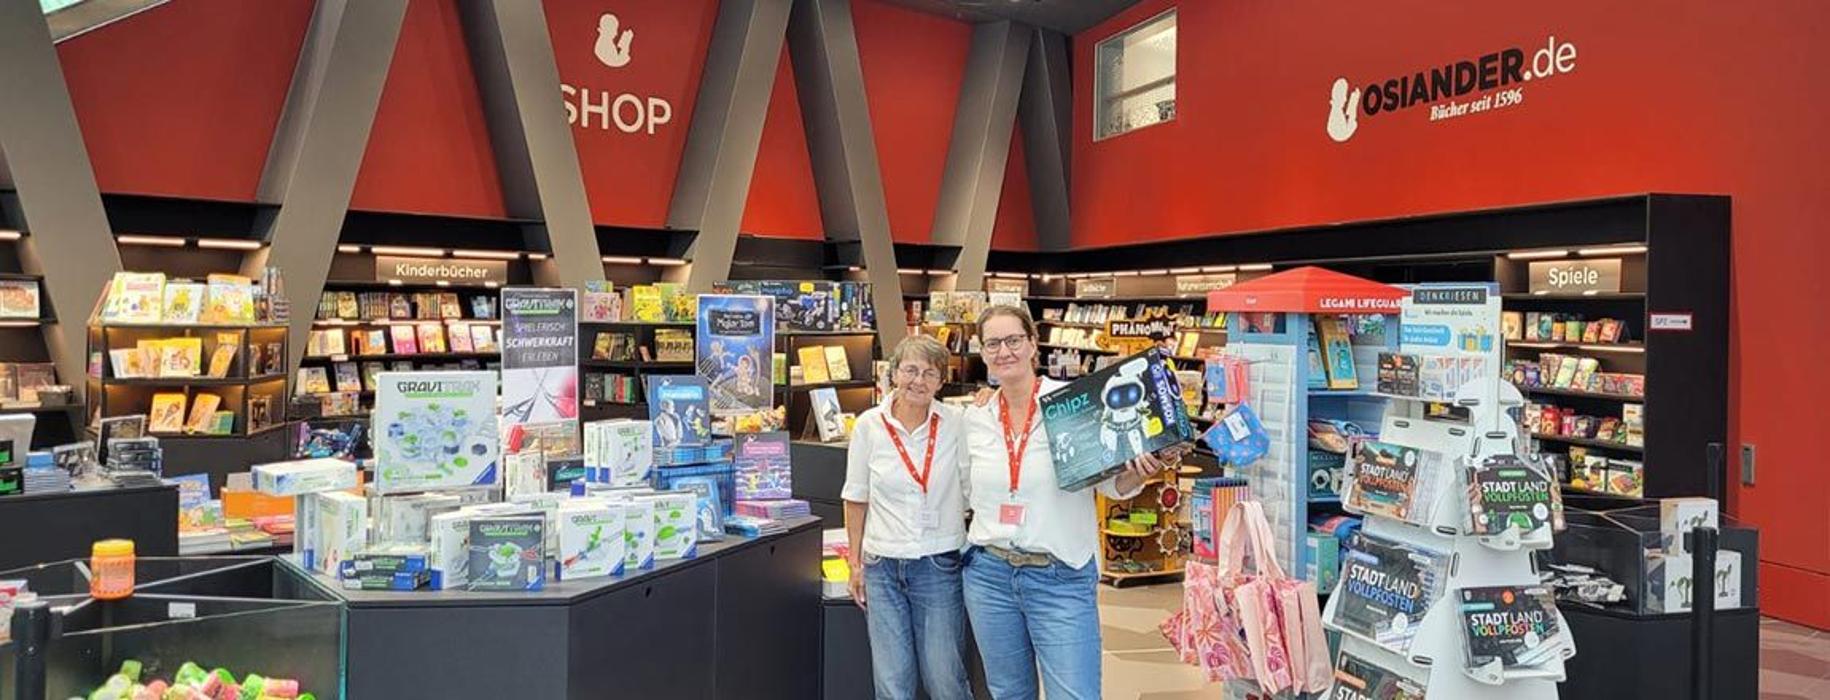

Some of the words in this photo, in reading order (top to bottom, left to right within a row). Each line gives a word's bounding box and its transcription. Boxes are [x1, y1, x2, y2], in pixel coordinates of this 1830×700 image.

[1362, 35, 1577, 116] OSIANDER.de
[560, 83, 672, 134] SHOP
[1430, 100, 1468, 121] Bücher
[1469, 95, 1491, 114] seit
[1493, 88, 1523, 109] 1596
[396, 264, 488, 279] Kinderbücher
[1549, 266, 1599, 287] Spiele
[1320, 298, 1355, 308] LEGAMI
[505, 336, 574, 349] SCHWERKRAFT
[1045, 392, 1090, 419] Chipz
[1156, 380, 1176, 425] KOSMOS
[1361, 463, 1386, 478] STADT
[1386, 468, 1409, 482] LAND
[1482, 481, 1516, 493] STADT
[1518, 481, 1548, 492] LAND
[1350, 564, 1387, 588] STADT
[1384, 575, 1418, 599] LAND
[1348, 579, 1414, 613] VOLLPFOSTEN
[1471, 611, 1509, 626] STADT
[1510, 610, 1543, 625] LAND
[1472, 622, 1545, 637] VOLLPFOSTEN
